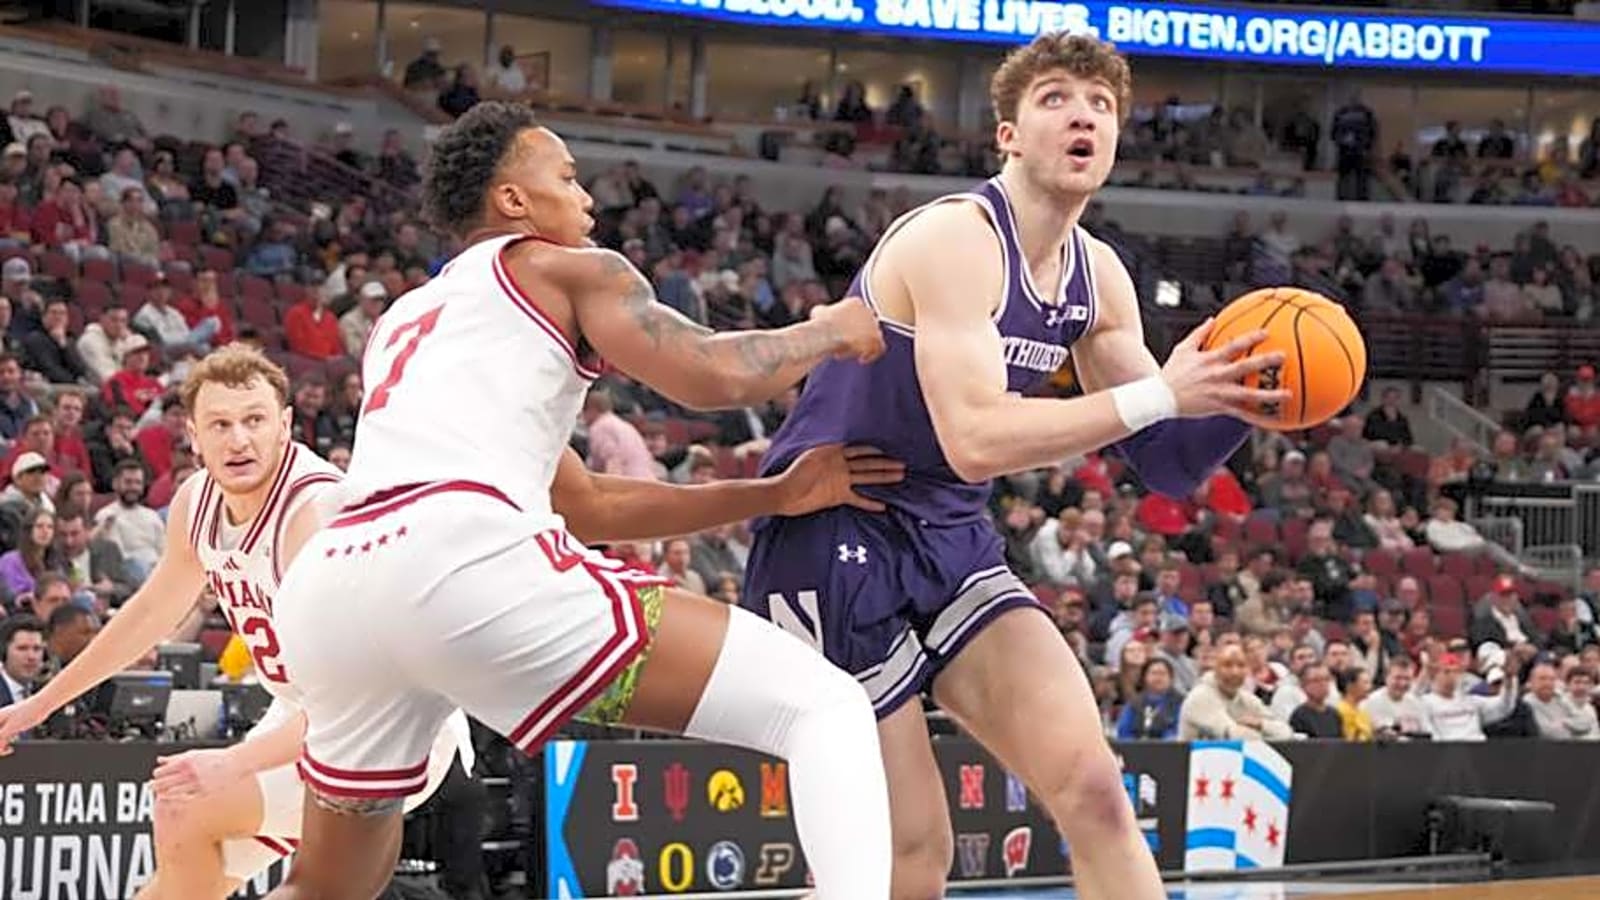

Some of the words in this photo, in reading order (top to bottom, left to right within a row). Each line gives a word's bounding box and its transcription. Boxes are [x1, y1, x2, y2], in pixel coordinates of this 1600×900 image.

[875, 0, 980, 31] SAVE
[1107, 7, 1491, 63] BIGTEN.ORG/ABBOTT
[0, 783, 25, 824] 6
[36, 782, 107, 824] TIAA
[755, 841, 795, 884] P
